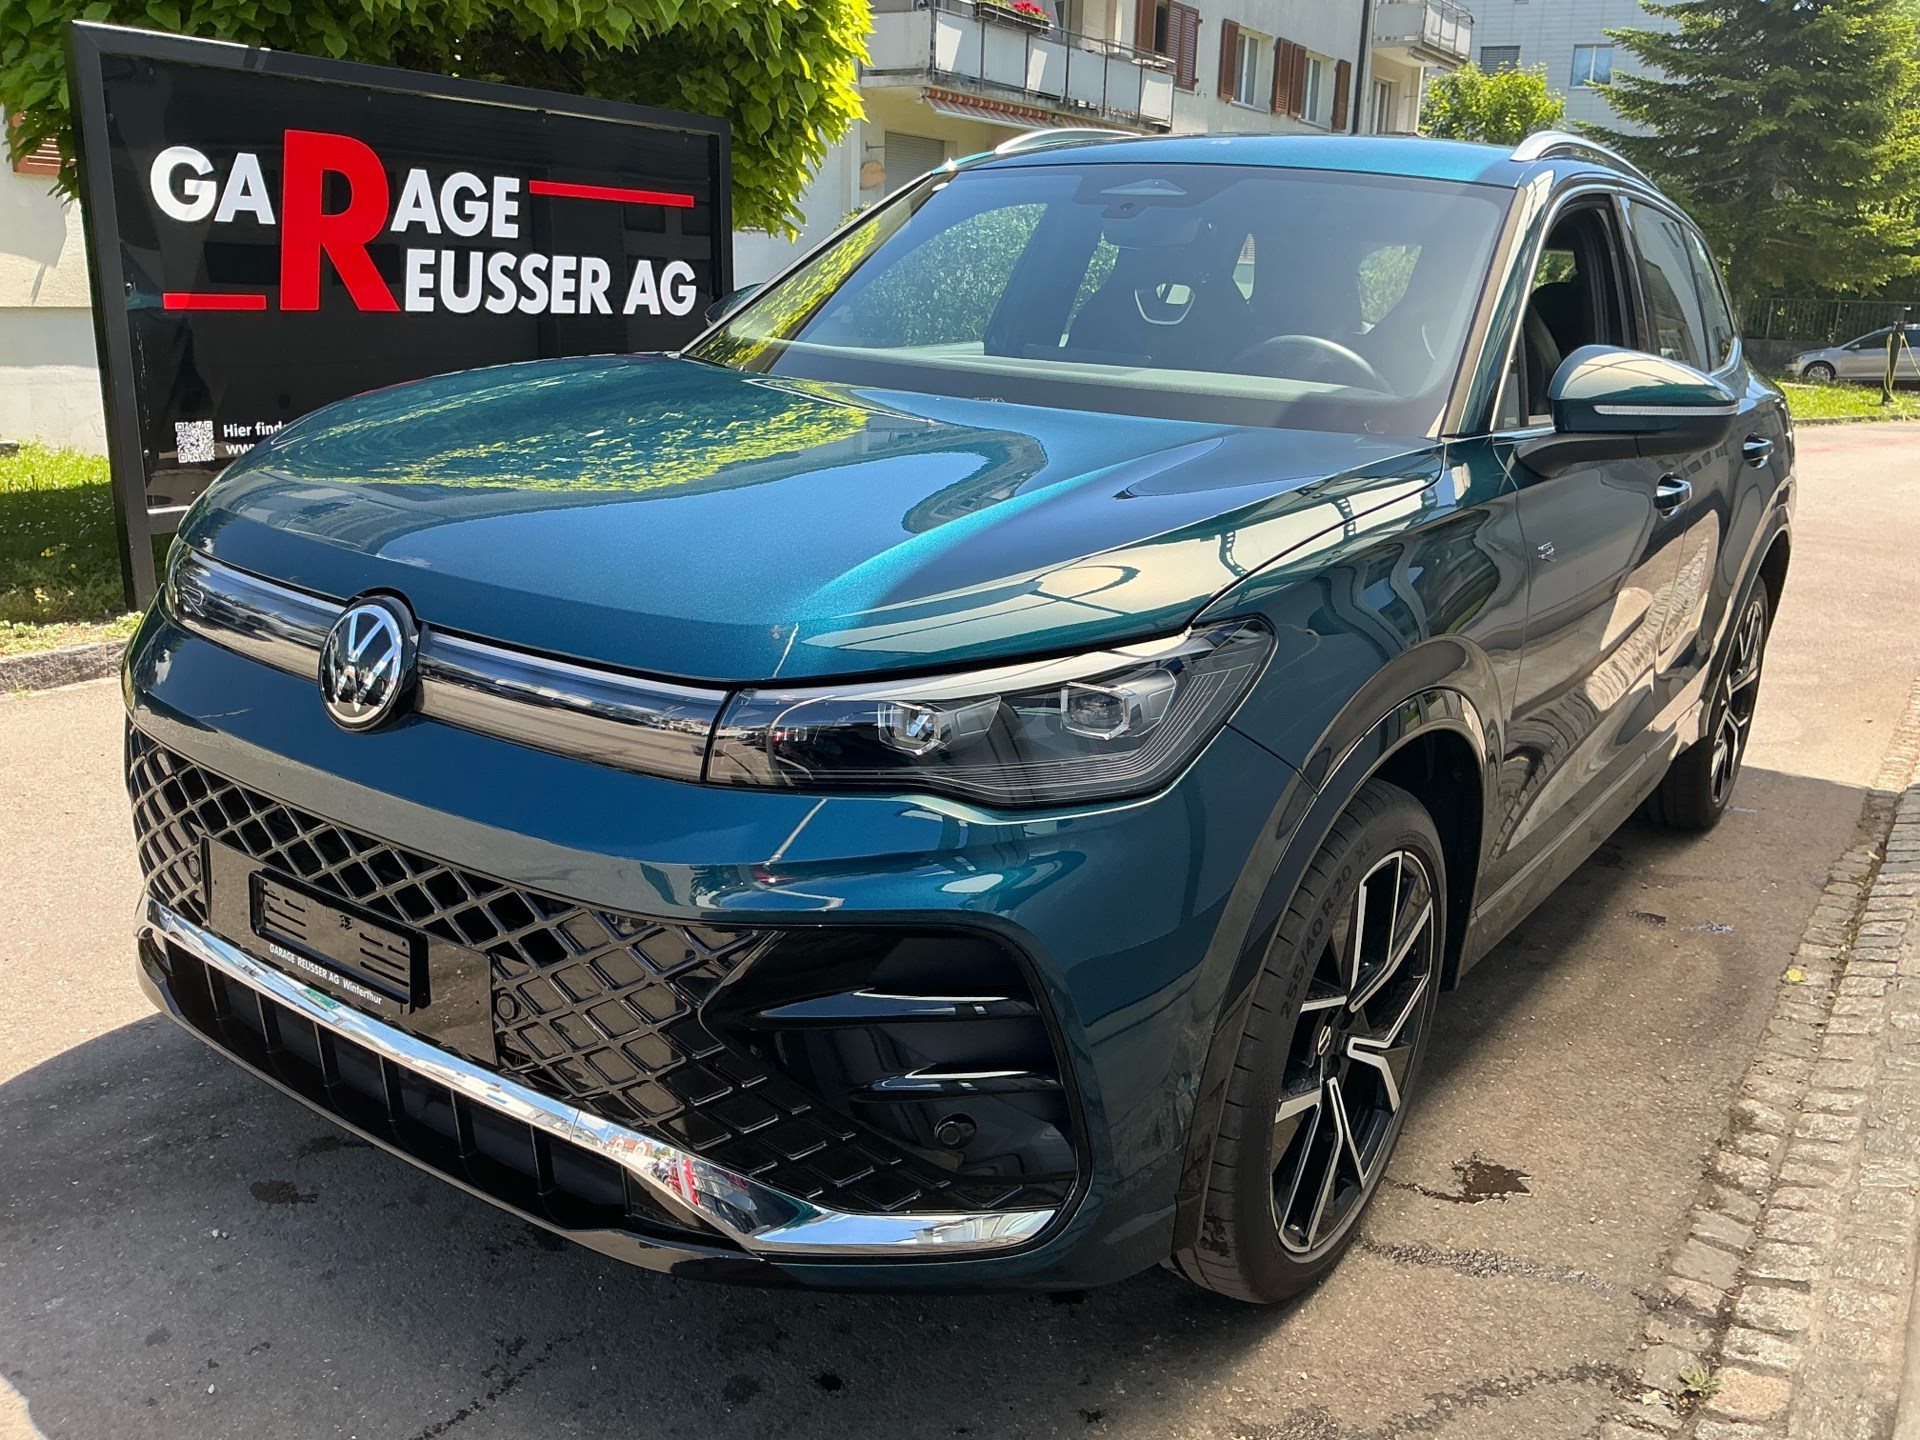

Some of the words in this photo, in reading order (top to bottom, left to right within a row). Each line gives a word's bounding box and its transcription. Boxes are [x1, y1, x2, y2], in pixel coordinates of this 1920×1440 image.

[150, 129, 520, 312] GARAGE
[622, 260, 697, 316] AG
[223, 423, 252, 438] Hier
[255, 421, 286, 436] find
[226, 443, 255, 455] ww
[269, 943, 295, 963] GARAGE
[298, 957, 327, 979] REUSSER
[327, 972, 340, 986] AG
[343, 978, 382, 1005] Winterthur
